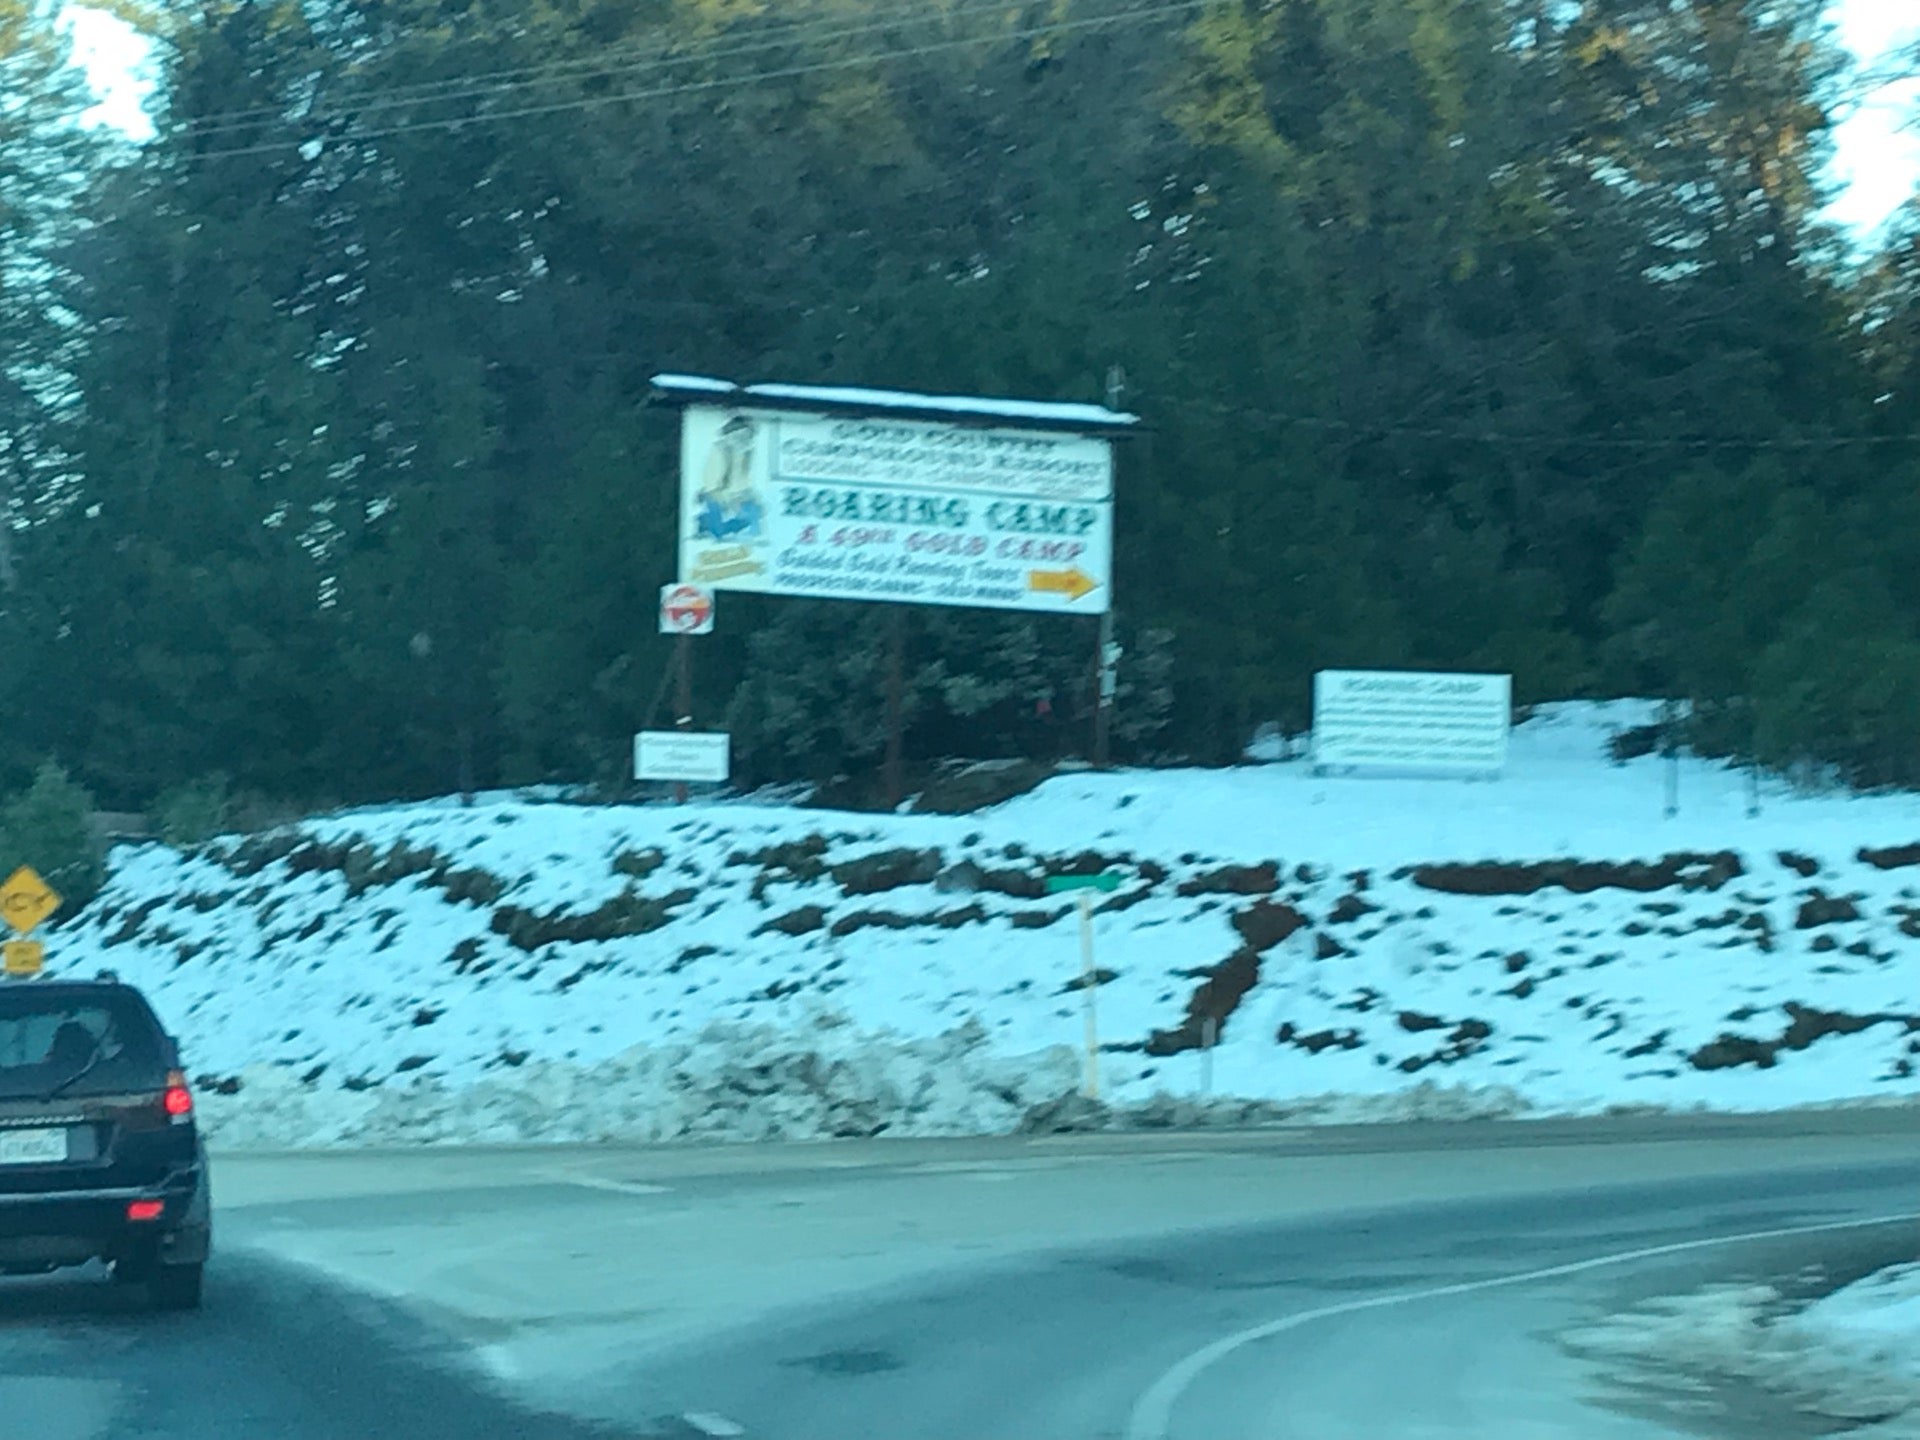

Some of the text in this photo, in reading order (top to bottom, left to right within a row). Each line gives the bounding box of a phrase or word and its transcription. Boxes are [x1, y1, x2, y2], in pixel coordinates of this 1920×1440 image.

[783, 438, 984, 467] CAMPGROUND
[783, 486, 1095, 535] ROARING CAMP
[796, 525, 818, 545] A
[905, 531, 987, 556] GOLD
[997, 537, 1085, 562] CAMP
